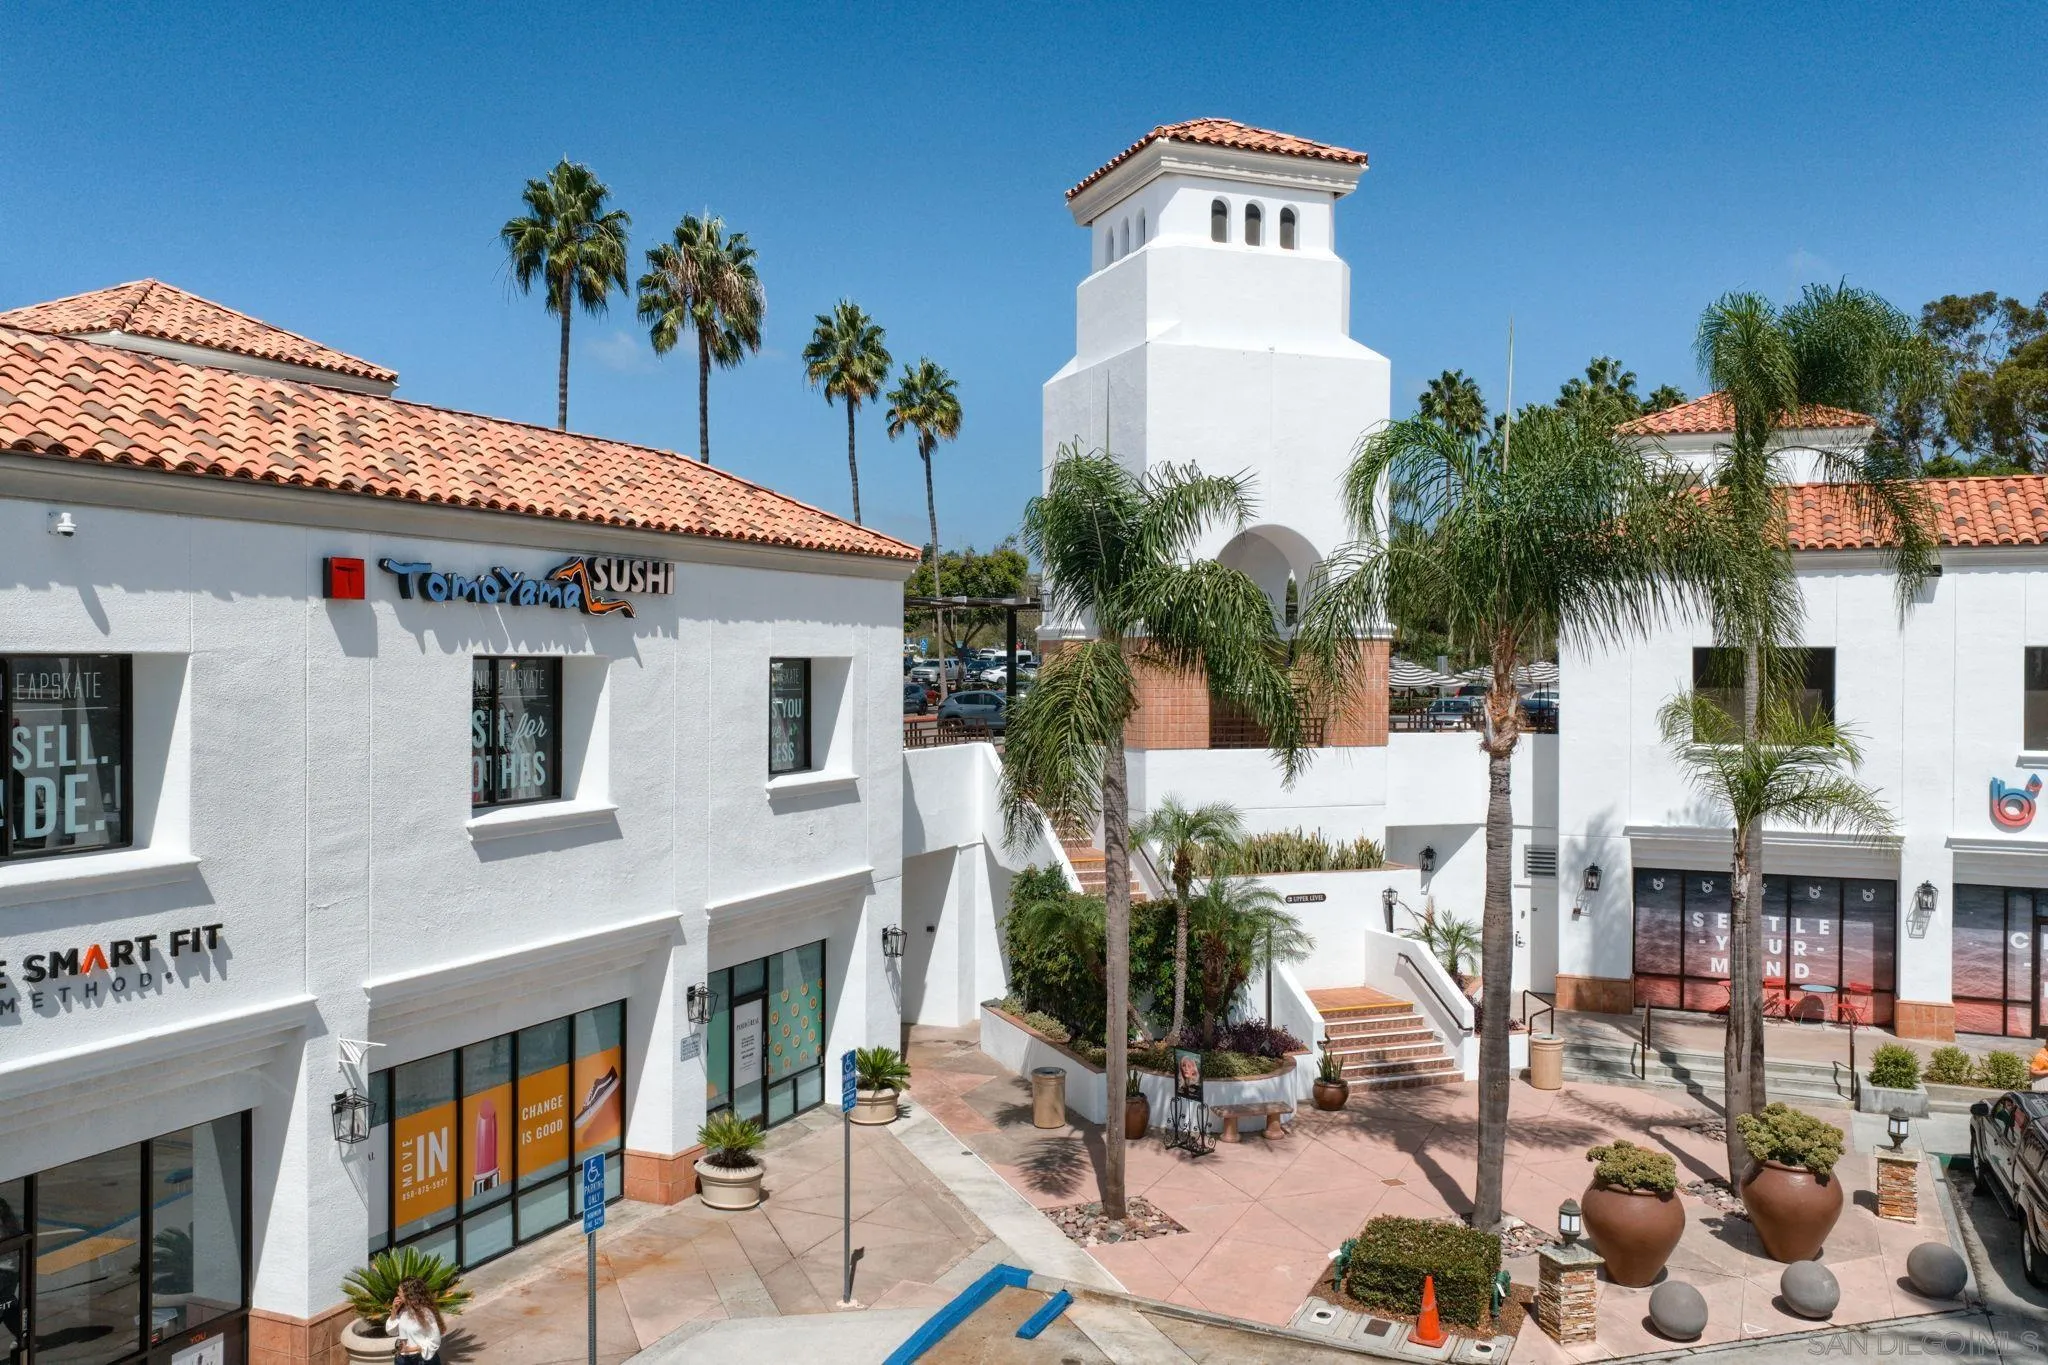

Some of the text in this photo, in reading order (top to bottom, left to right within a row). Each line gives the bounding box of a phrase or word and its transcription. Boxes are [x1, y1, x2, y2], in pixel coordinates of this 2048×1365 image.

[592, 556, 674, 595] SUSHI
[782, 698, 802, 719] YOU
[510, 711, 548, 751] for
[13, 723, 108, 770] SELL.
[1692, 911, 1830, 935] SETLE
[23, 934, 158, 984] SMART
[169, 923, 223, 957] FIT
[1698, 935, 1825, 957] -YUR-
[1710, 957, 1810, 979] MND
[522, 1094, 564, 1121] CHANGE
[522, 1118, 563, 1146] IS GOOD
[402, 1138, 413, 1188] MOVE
[416, 1126, 448, 1182] IN
[584, 1178, 605, 1194] PARKING
